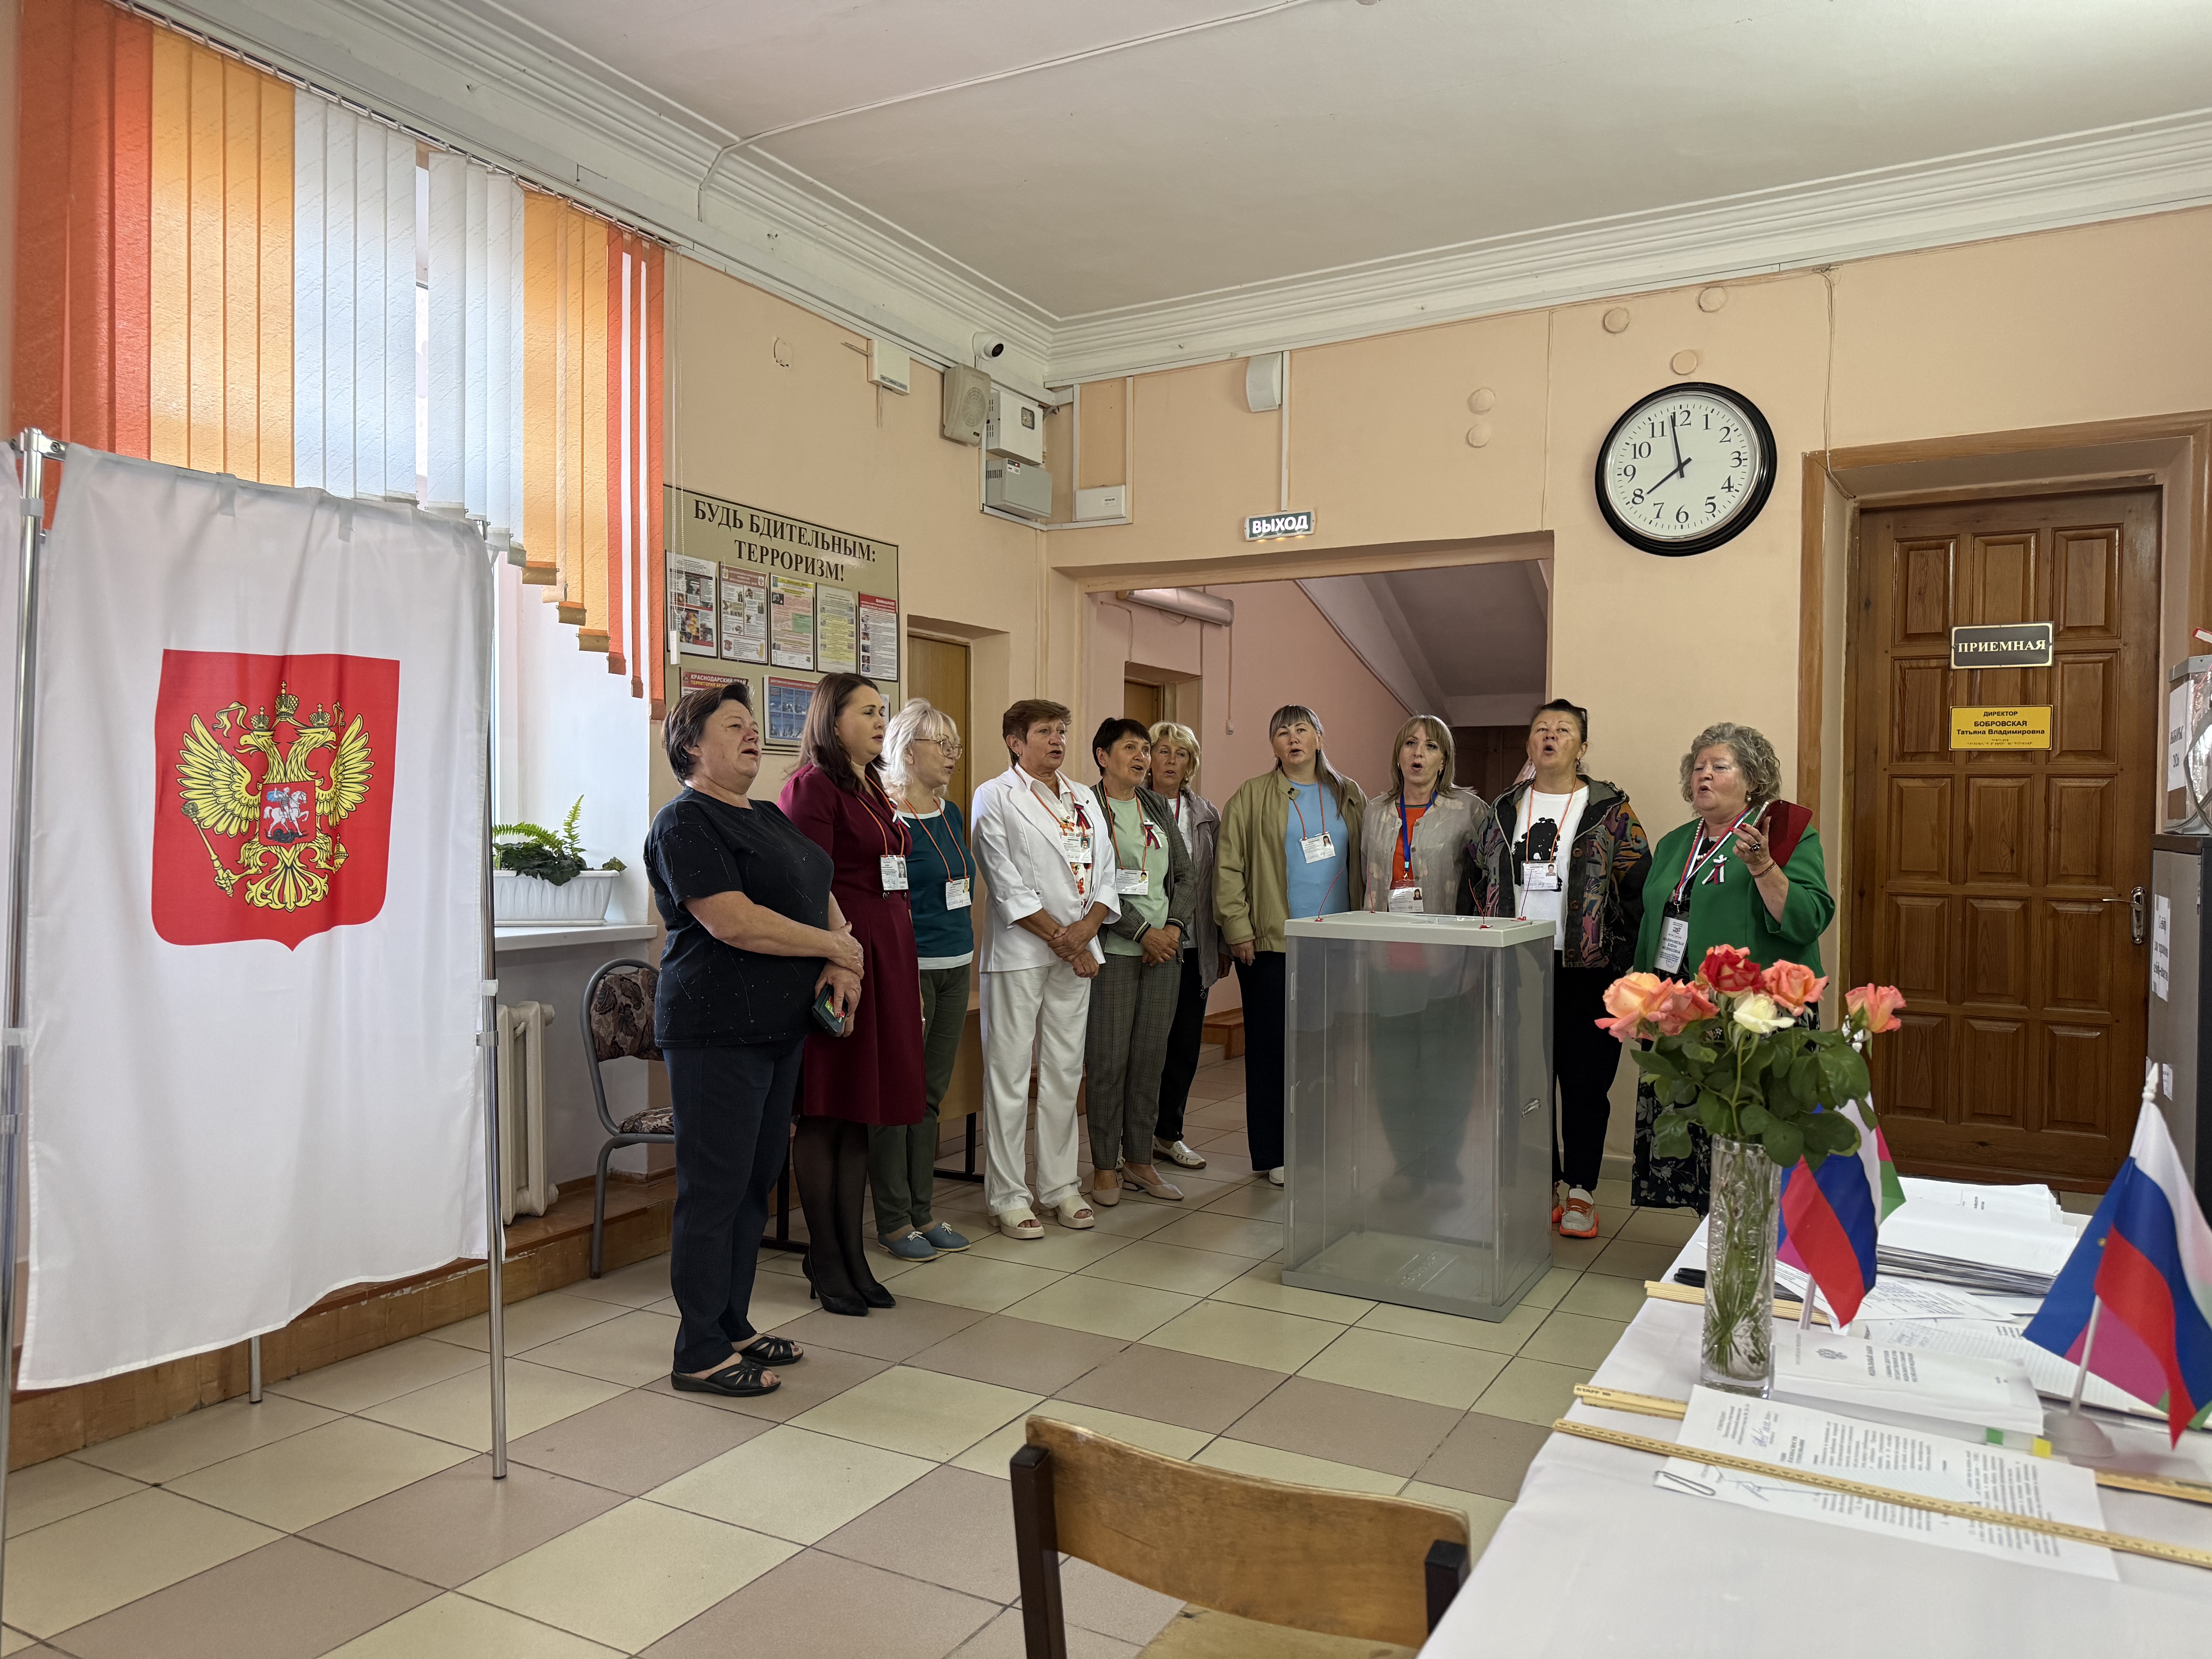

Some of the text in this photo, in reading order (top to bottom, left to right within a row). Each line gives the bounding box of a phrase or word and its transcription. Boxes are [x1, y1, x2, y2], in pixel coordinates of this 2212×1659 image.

[1670, 410, 1692, 427] 12
[1703, 413, 1711, 430] 1
[1648, 421, 1667, 438] 11
[1719, 426, 1731, 443] 2
[1630, 441, 1651, 459] 10
[1729, 451, 1742, 468] 3
[1623, 465, 1636, 483] 9
[1721, 475, 1734, 493] 4
[1631, 488, 1644, 505] 8
[1704, 496, 1716, 514] 5
[1653, 502, 1664, 519] 7
[1676, 505, 1689, 523] 6
[694, 499, 876, 562] БУДЬ БДИТЕЛЬНЫМ:
[1252, 515, 1309, 534] ВЫХОД
[734, 539, 844, 581] ТЕРРОРИЗМ!
[1958, 640, 2046, 653] ПРИЕМНАЯ
[691, 674, 733, 683] КРАСНОДАРСКИЙ
